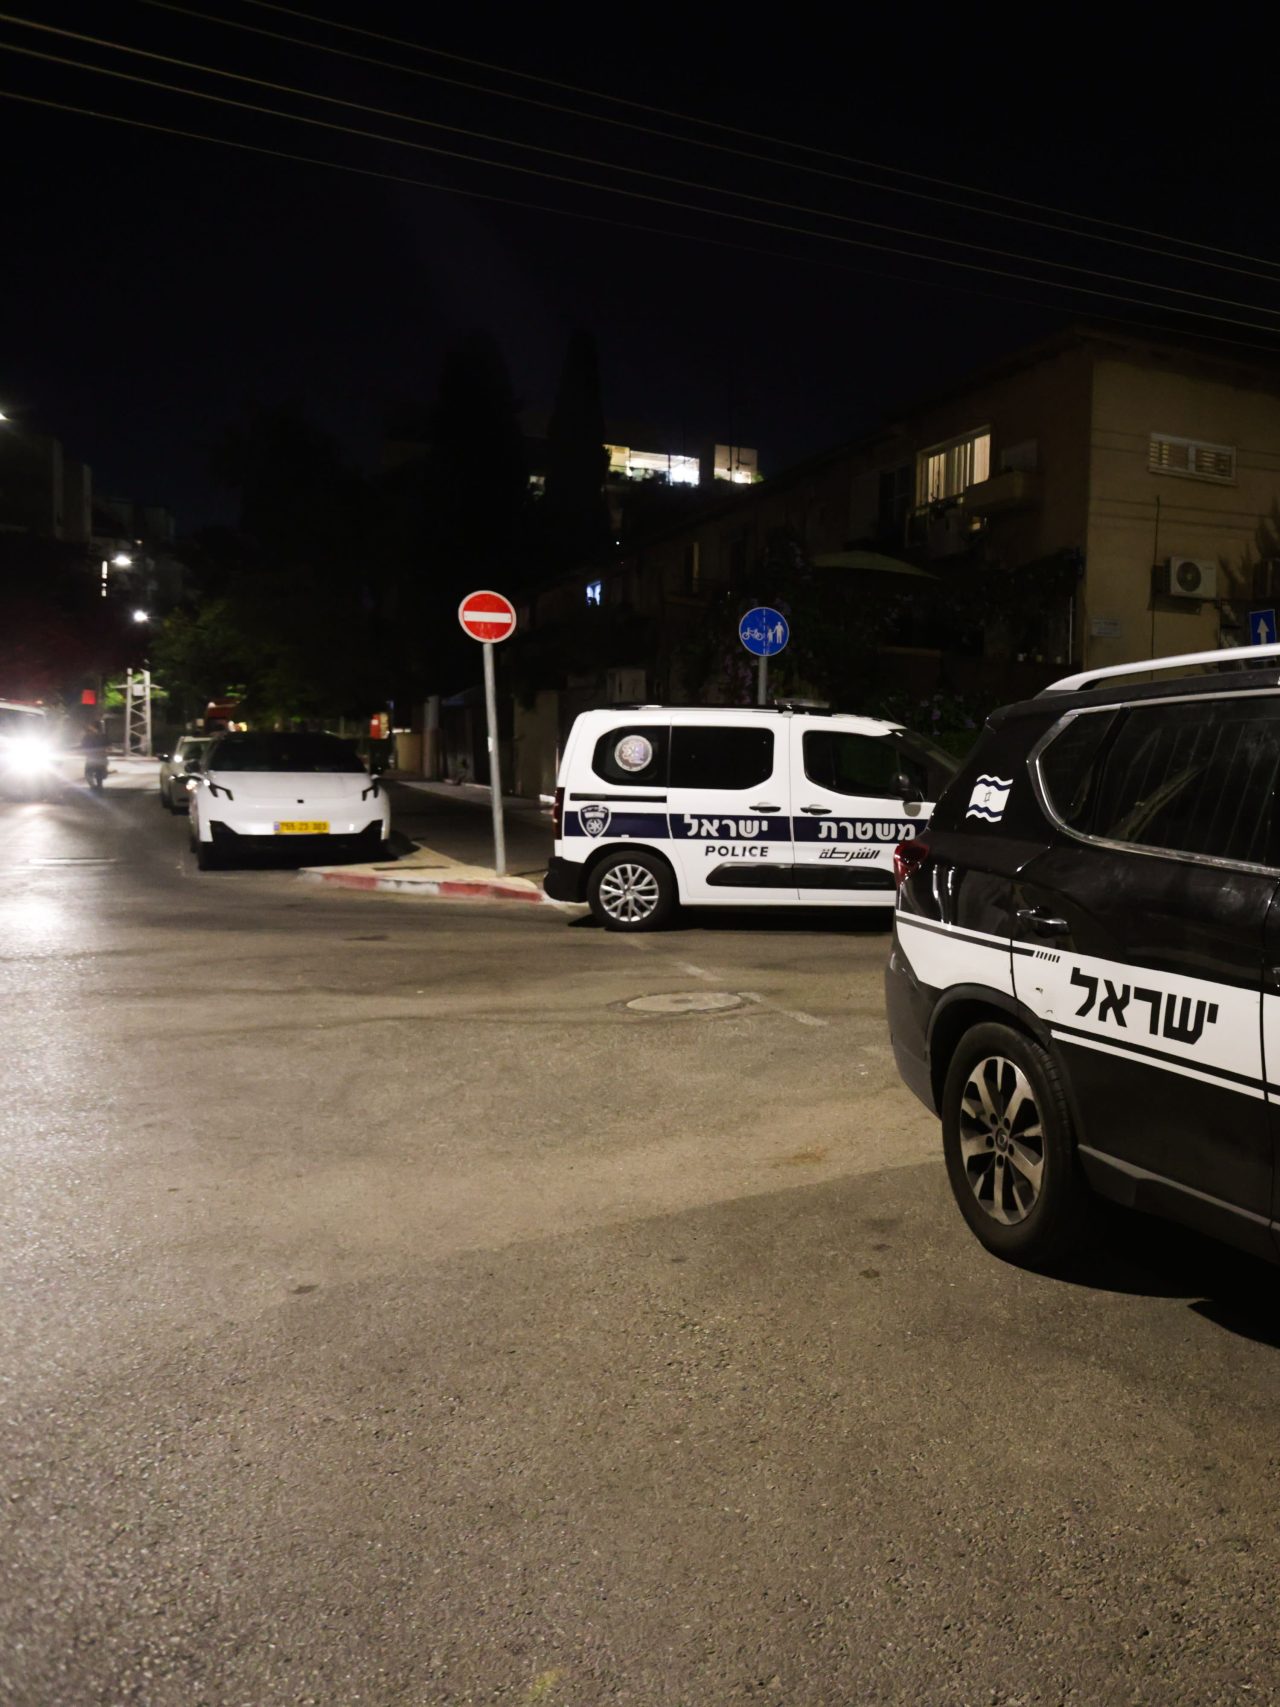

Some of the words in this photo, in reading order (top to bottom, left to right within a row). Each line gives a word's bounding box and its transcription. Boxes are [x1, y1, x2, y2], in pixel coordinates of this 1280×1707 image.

[683, 814, 769, 838] ישראל
[818, 821, 916, 841] משטרת
[705, 845, 769, 857] POLICE
[819, 846, 881, 862] الشرطة
[1070, 967, 1219, 1045] ישראל
